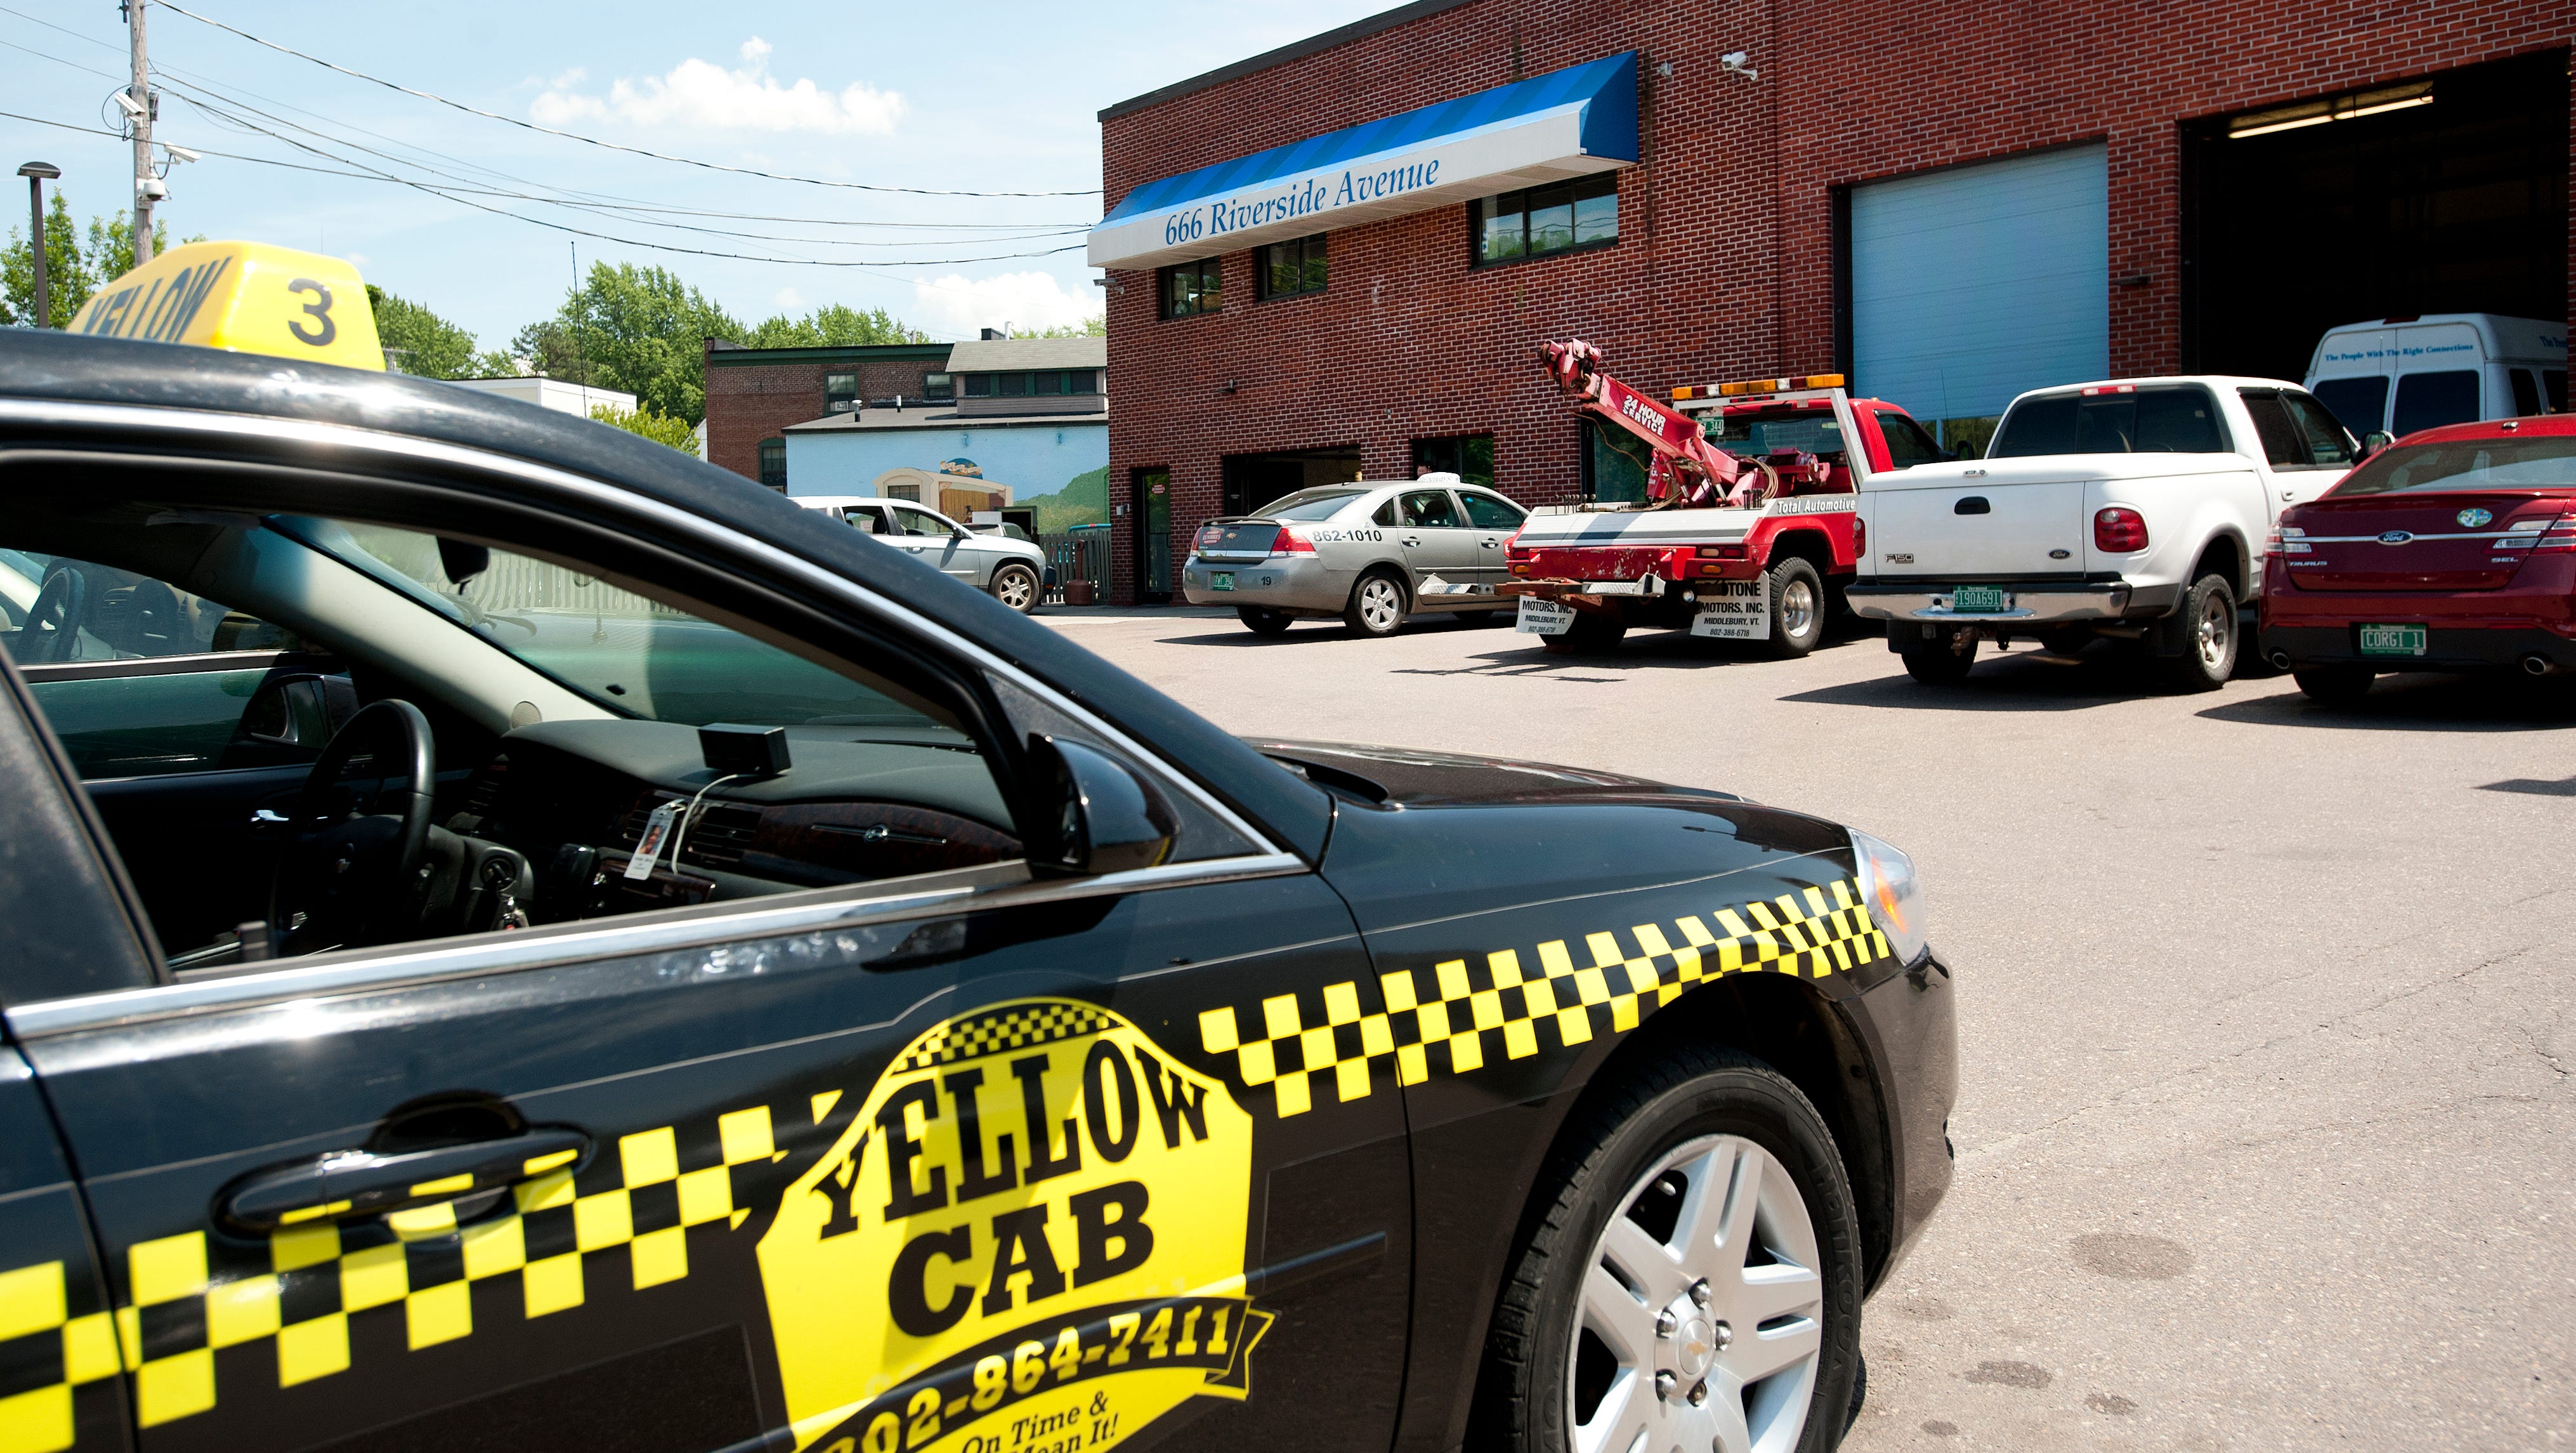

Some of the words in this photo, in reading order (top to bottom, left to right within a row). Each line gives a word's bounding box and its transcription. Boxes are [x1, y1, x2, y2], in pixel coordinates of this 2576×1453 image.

[1166, 207, 1203, 245] 666
[1209, 178, 1326, 235] Riverside
[1334, 159, 1440, 206] Avenue
[82, 255, 233, 343] YELLOW
[288, 278, 336, 346] 3
[2341, 352, 2364, 362] People
[2403, 348, 2423, 356] Right
[2426, 343, 2473, 353] Connections
[1622, 404, 1664, 437] SERVICE
[1624, 395, 1638, 409] 24
[1638, 403, 1666, 428] HOUR
[1777, 500, 1801, 515] Total
[1803, 497, 1856, 513] Automotive
[1312, 530, 1382, 541] 862-1010
[2383, 532, 2405, 542] Ford
[1261, 576, 1272, 586] 19
[1722, 582, 1762, 596] TONE
[1701, 602, 1743, 614] MOTORS,
[1746, 602, 1765, 614] INC.
[1959, 592, 1999, 605] 190A691
[1704, 617, 1748, 626] MIDDLEBURY,
[2366, 632, 2403, 647] CORGI
[2413, 632, 2420, 647] 1
[810, 1039, 1210, 1240] YELLOW
[888, 1179, 1154, 1337] CAB
[962, 1435, 1001, 1453] On
[1011, 1405, 1080, 1447] Time
[1089, 1391, 1109, 1416] &
[1089, 1412, 1118, 1446] It!
